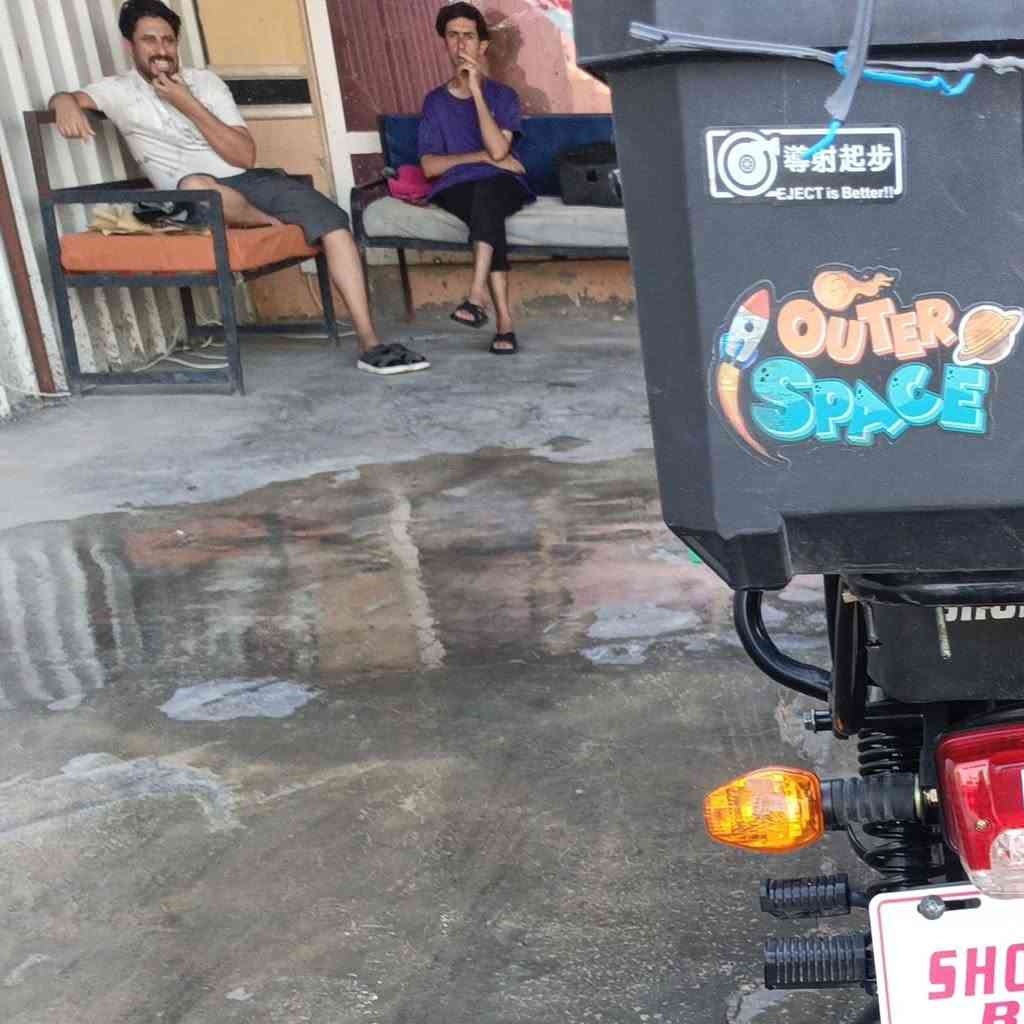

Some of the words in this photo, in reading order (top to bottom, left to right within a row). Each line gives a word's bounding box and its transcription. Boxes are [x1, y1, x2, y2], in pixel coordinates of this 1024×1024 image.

[776, 187, 823, 200] EJECT
[826, 187, 839, 199] is
[841, 186, 895, 199] Better!!
[777, 297, 958, 364] OUTER
[752, 357, 990, 445] SPACE
